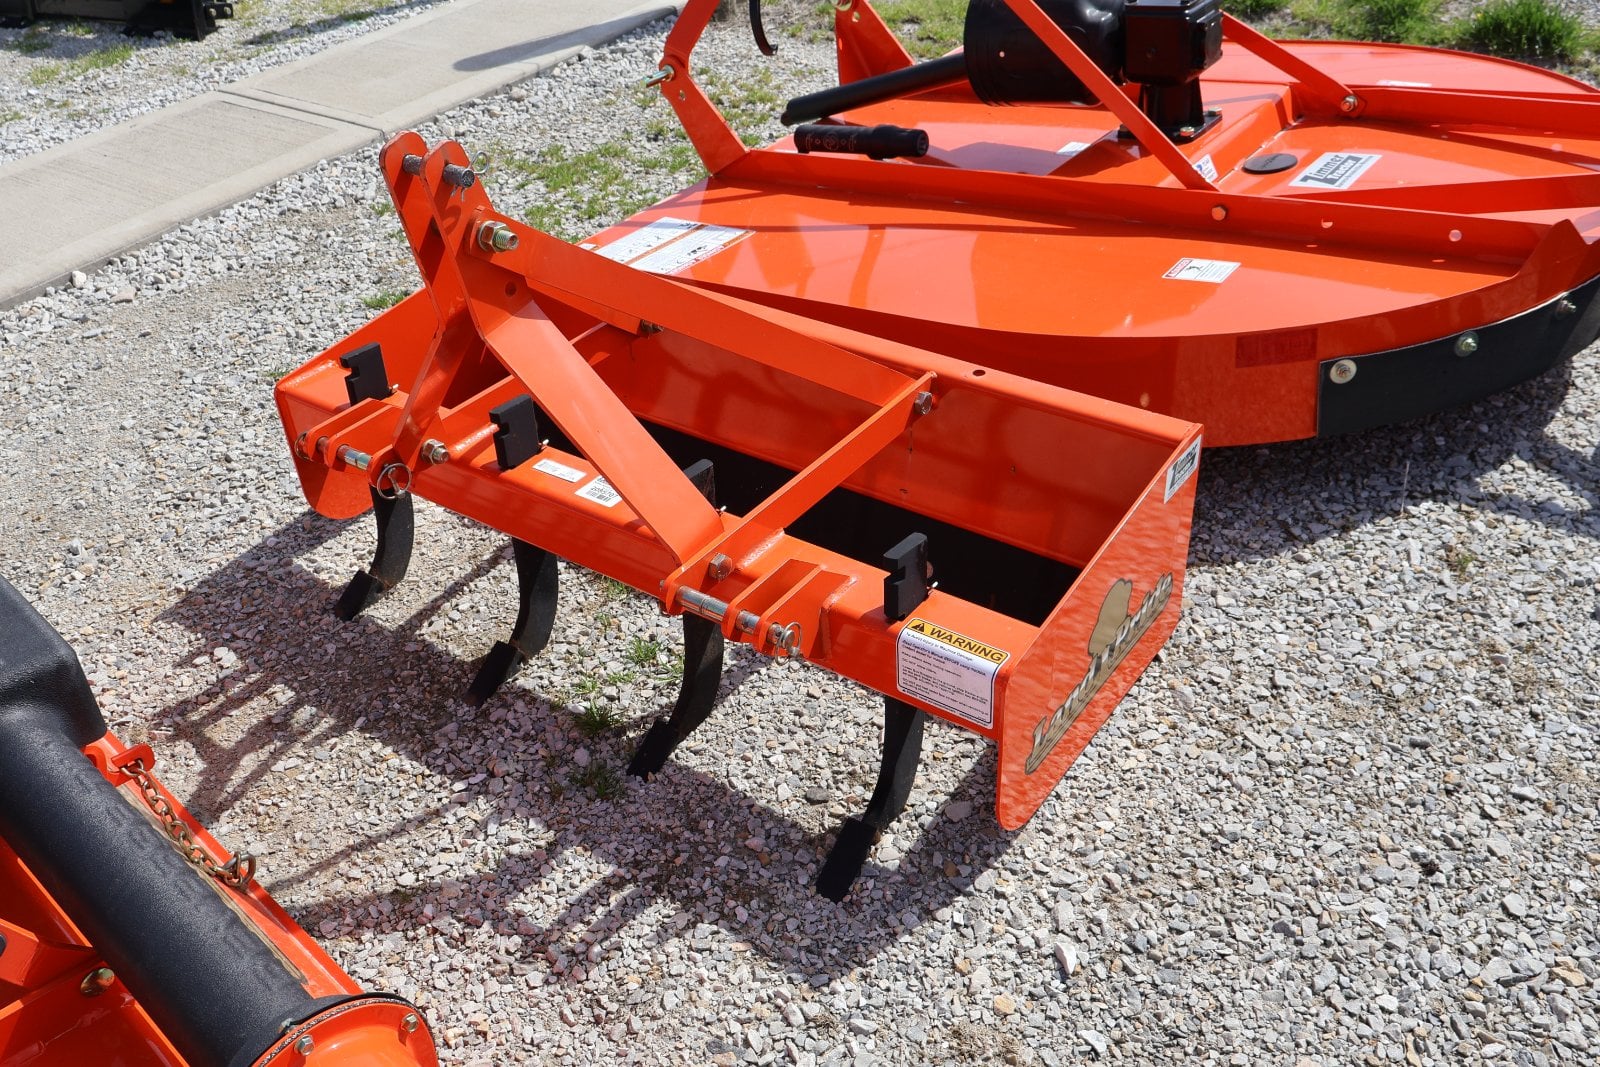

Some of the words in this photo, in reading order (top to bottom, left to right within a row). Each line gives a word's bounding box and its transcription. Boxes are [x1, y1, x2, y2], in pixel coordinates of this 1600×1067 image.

[930, 627, 1004, 662] WARNING
[1031, 652, 1103, 748] Land
[1112, 572, 1173, 648] Pride
